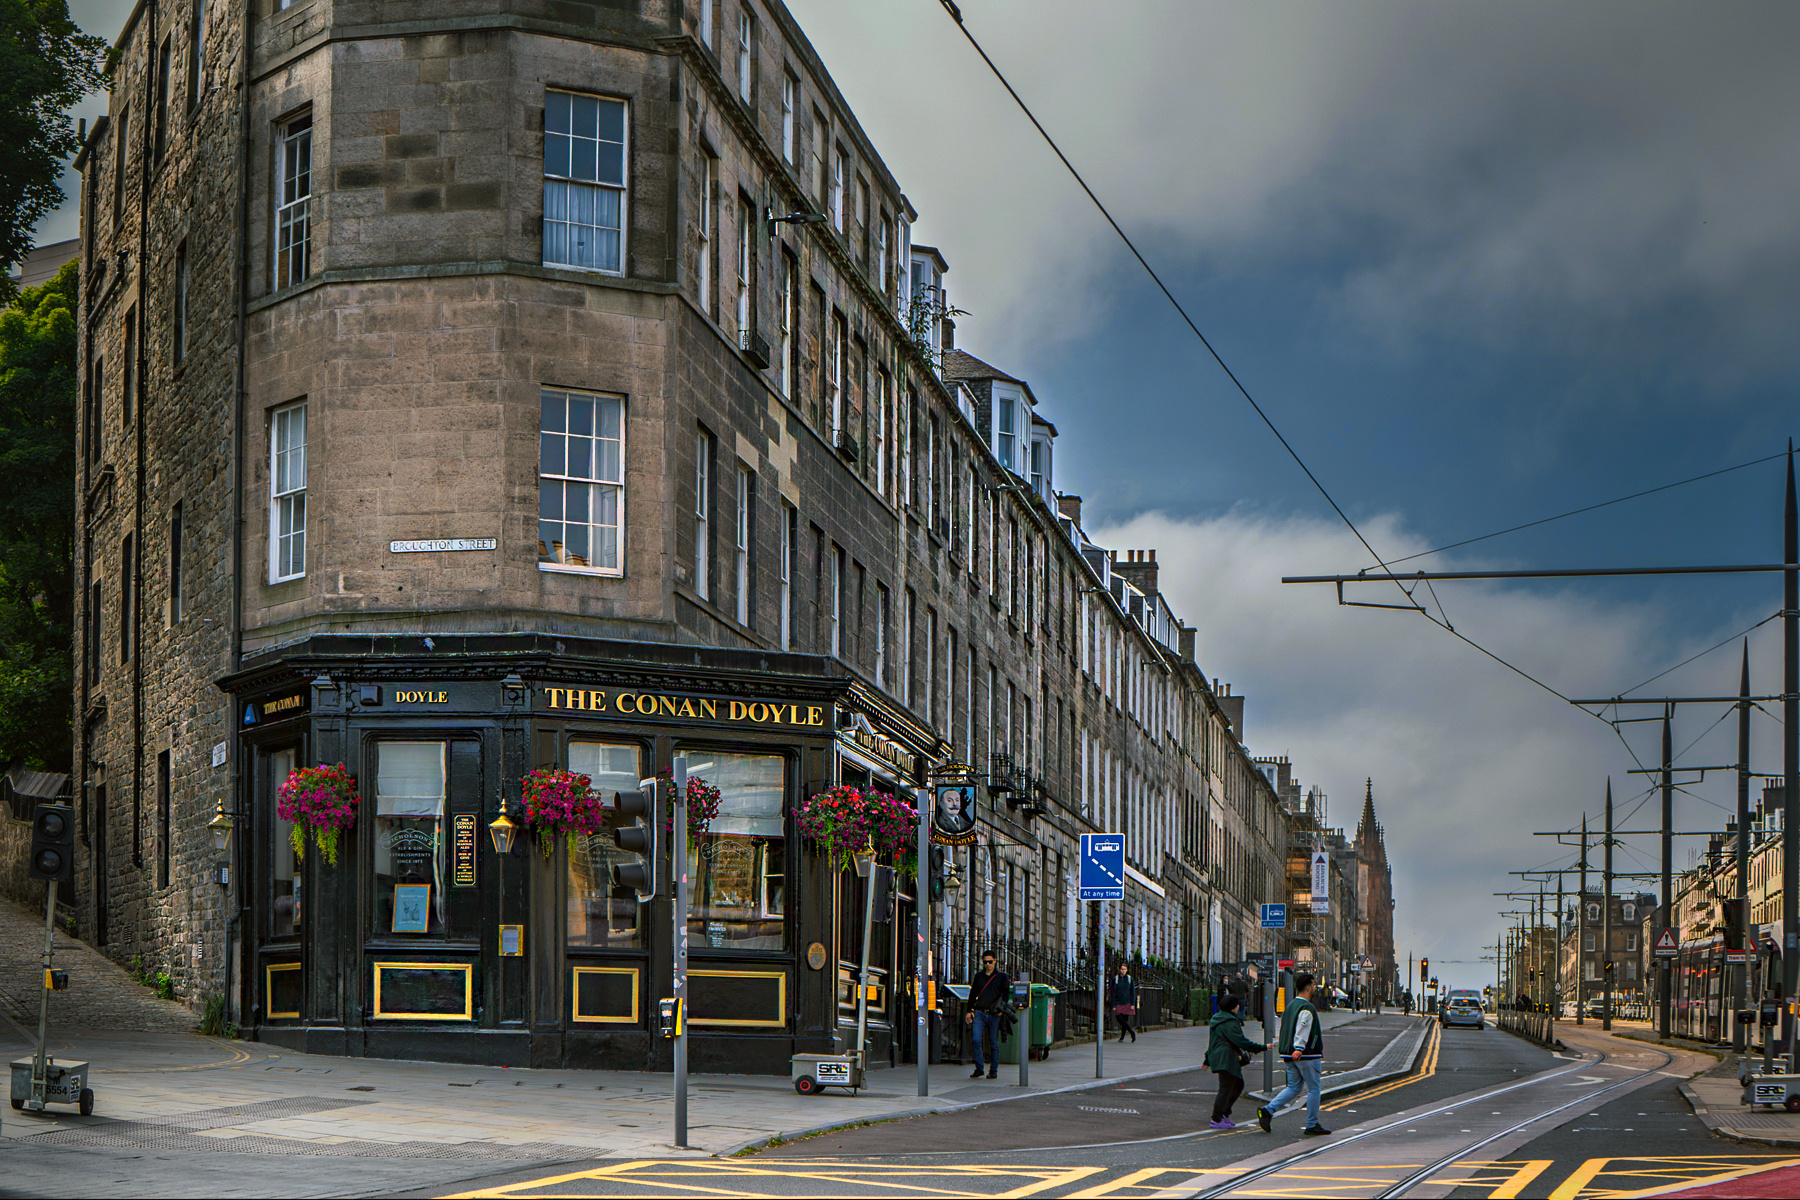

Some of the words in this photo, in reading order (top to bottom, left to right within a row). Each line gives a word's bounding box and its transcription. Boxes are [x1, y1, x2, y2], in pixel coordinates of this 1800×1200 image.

[393, 542, 453, 551] BROUGHTON
[458, 540, 494, 549] STREET
[396, 691, 448, 703] DOYLE
[545, 687, 607, 711] THE
[616, 692, 717, 719] CONAN
[729, 701, 823, 726] DOYLE
[385, 833, 435, 845] NICHOLSON'S
[934, 834, 953, 844] CONAN
[955, 834, 976, 845] DOYLE
[819, 1064, 847, 1073] SRL
[70, 1078, 80, 1089] SRL
[1757, 1086, 1785, 1094] SRL
